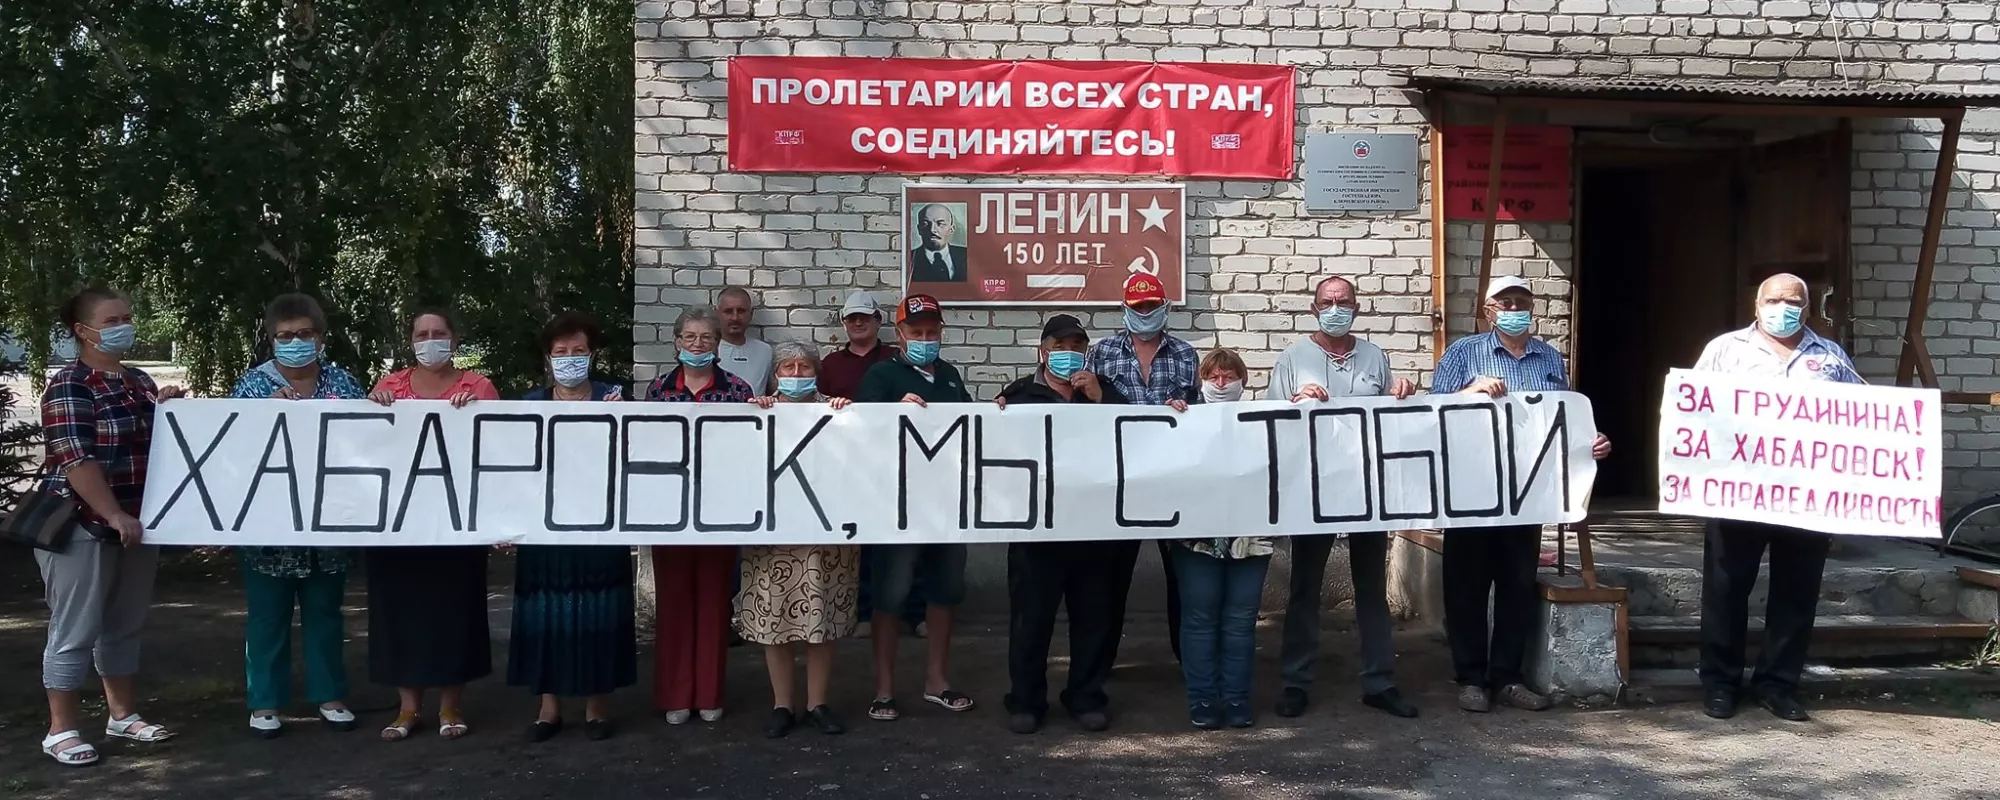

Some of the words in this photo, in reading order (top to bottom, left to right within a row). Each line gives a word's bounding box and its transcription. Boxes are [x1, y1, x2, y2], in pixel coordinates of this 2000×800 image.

[752, 77, 1011, 108] ПРОЛЕТАРИИ
[1025, 80, 1126, 108] ВСЕХ
[1137, 82, 1274, 118] СТРАН,
[851, 123, 1175, 159] СОЕДИНЯЙТЕСЬ!
[975, 192, 1130, 235] ЛЕНИН
[1472, 198, 1535, 212] КРФ
[1003, 242, 1045, 266] 150
[1056, 242, 1106, 267] ЛЕТ
[1676, 383, 1715, 413] ЗА
[1734, 389, 1924, 436] ГРУДИНИНА!
[147, 411, 857, 539] ХАБАРОВСК,
[897, 413, 1054, 531] МЫ
[1114, 414, 1181, 528] С
[1237, 393, 1570, 526] ТОБОЙ
[1673, 427, 1711, 460] ЗА
[1731, 433, 1927, 481] ХАБАРОВСК!
[1663, 474, 1692, 503] ЗА
